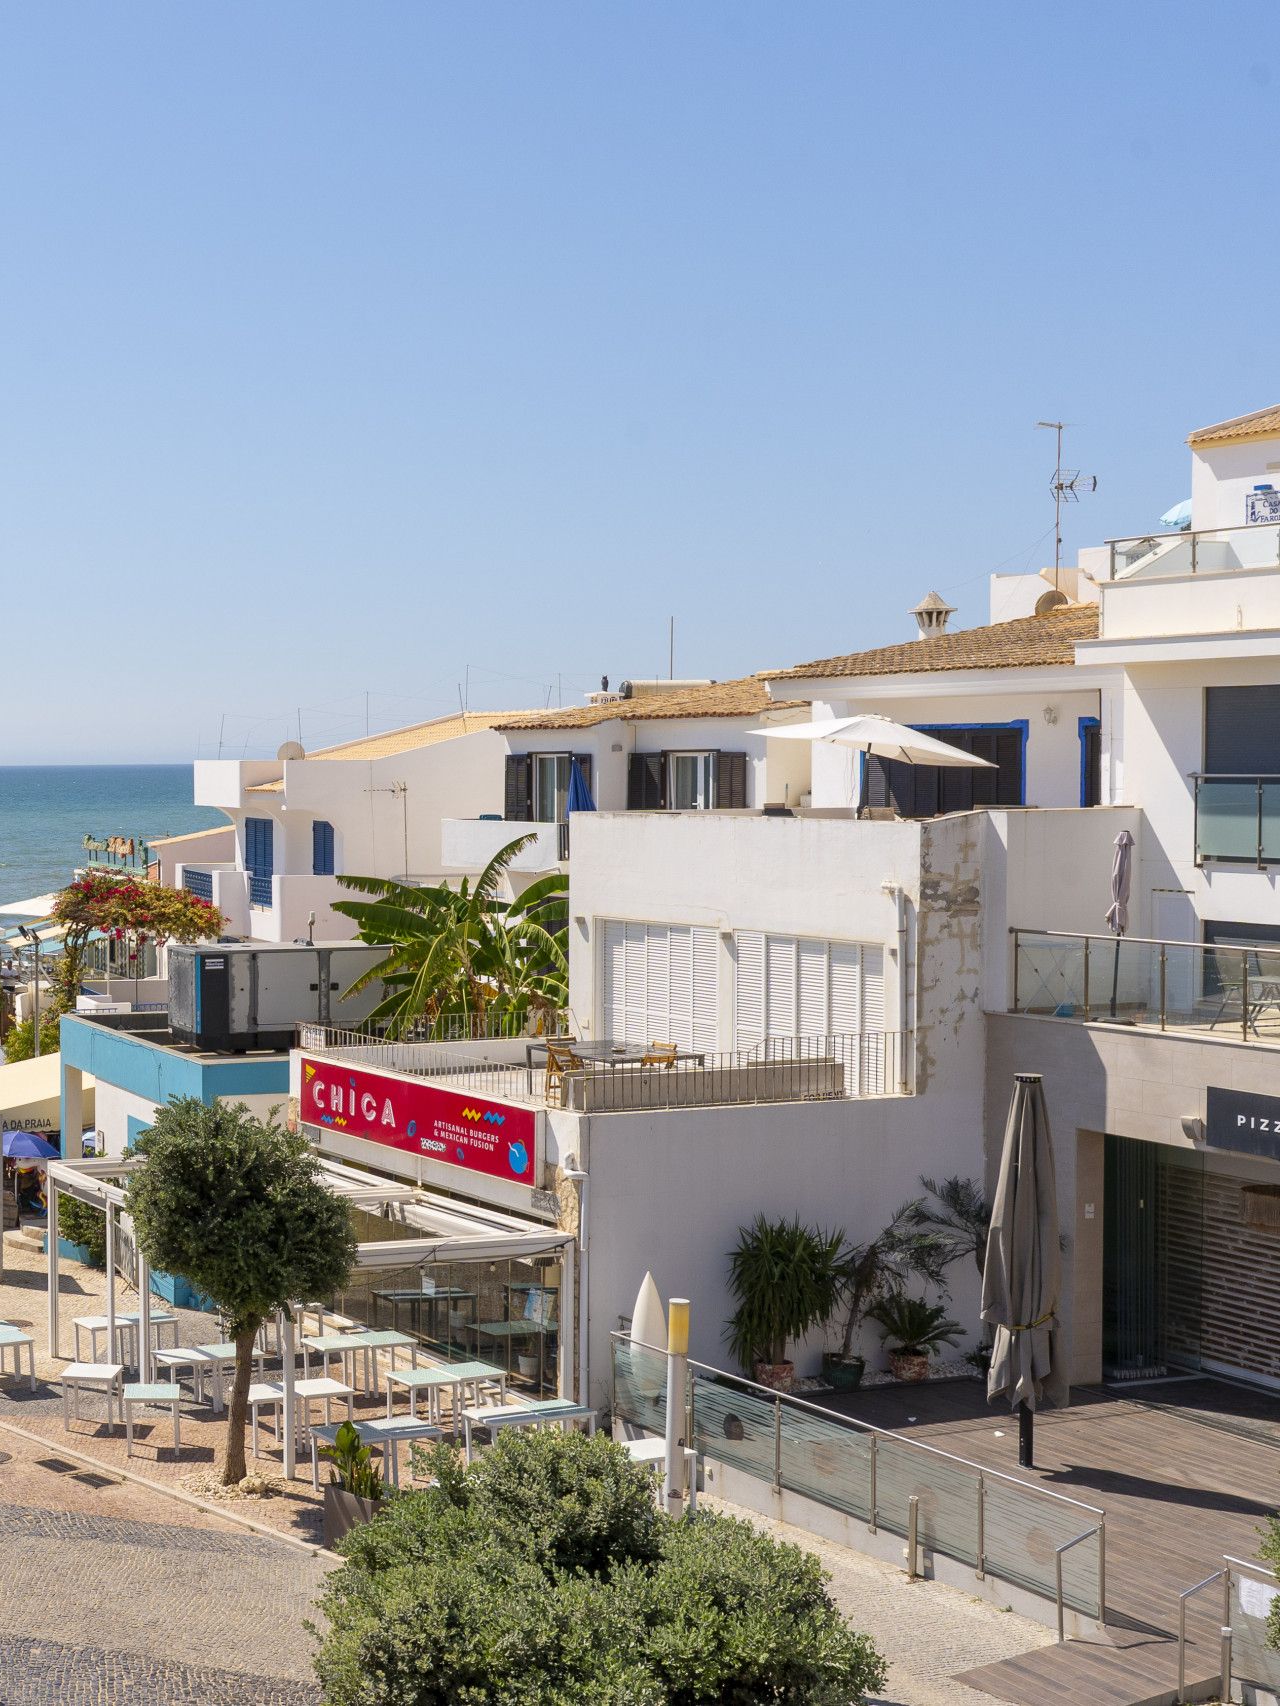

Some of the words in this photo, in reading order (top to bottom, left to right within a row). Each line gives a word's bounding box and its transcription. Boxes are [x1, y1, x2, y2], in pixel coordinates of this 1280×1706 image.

[312, 1080, 396, 1128] CHICA
[11, 1119, 23, 1129] DA
[25, 1118, 52, 1129] PRAIA
[434, 1119, 468, 1136] ARTISANAL
[469, 1128, 499, 1143] BURGERS
[433, 1128, 439, 1137] &
[440, 1130, 469, 1145] MEXICAN
[470, 1138, 494, 1152] FUSION
